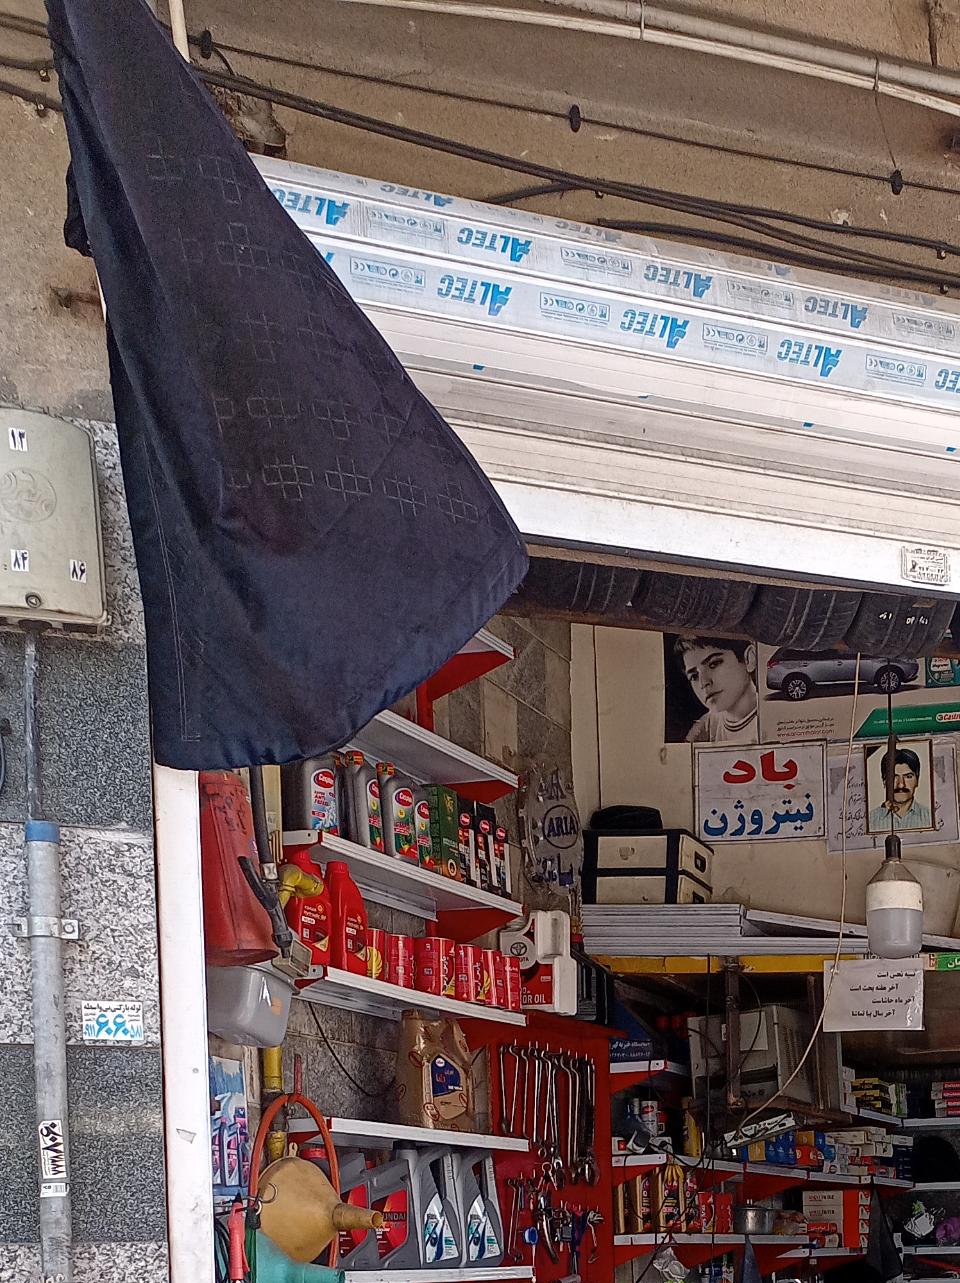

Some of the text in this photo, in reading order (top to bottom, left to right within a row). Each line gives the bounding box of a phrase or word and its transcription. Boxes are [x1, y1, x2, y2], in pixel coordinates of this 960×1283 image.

[13, 551, 28, 570] ۸۴
[71, 563, 86, 581] ۸۶
[723, 751, 798, 789] باد
[703, 793, 814, 837] نیتروژن
[547, 816, 577, 837] ARIA
[534, 993, 546, 1004] OIL
